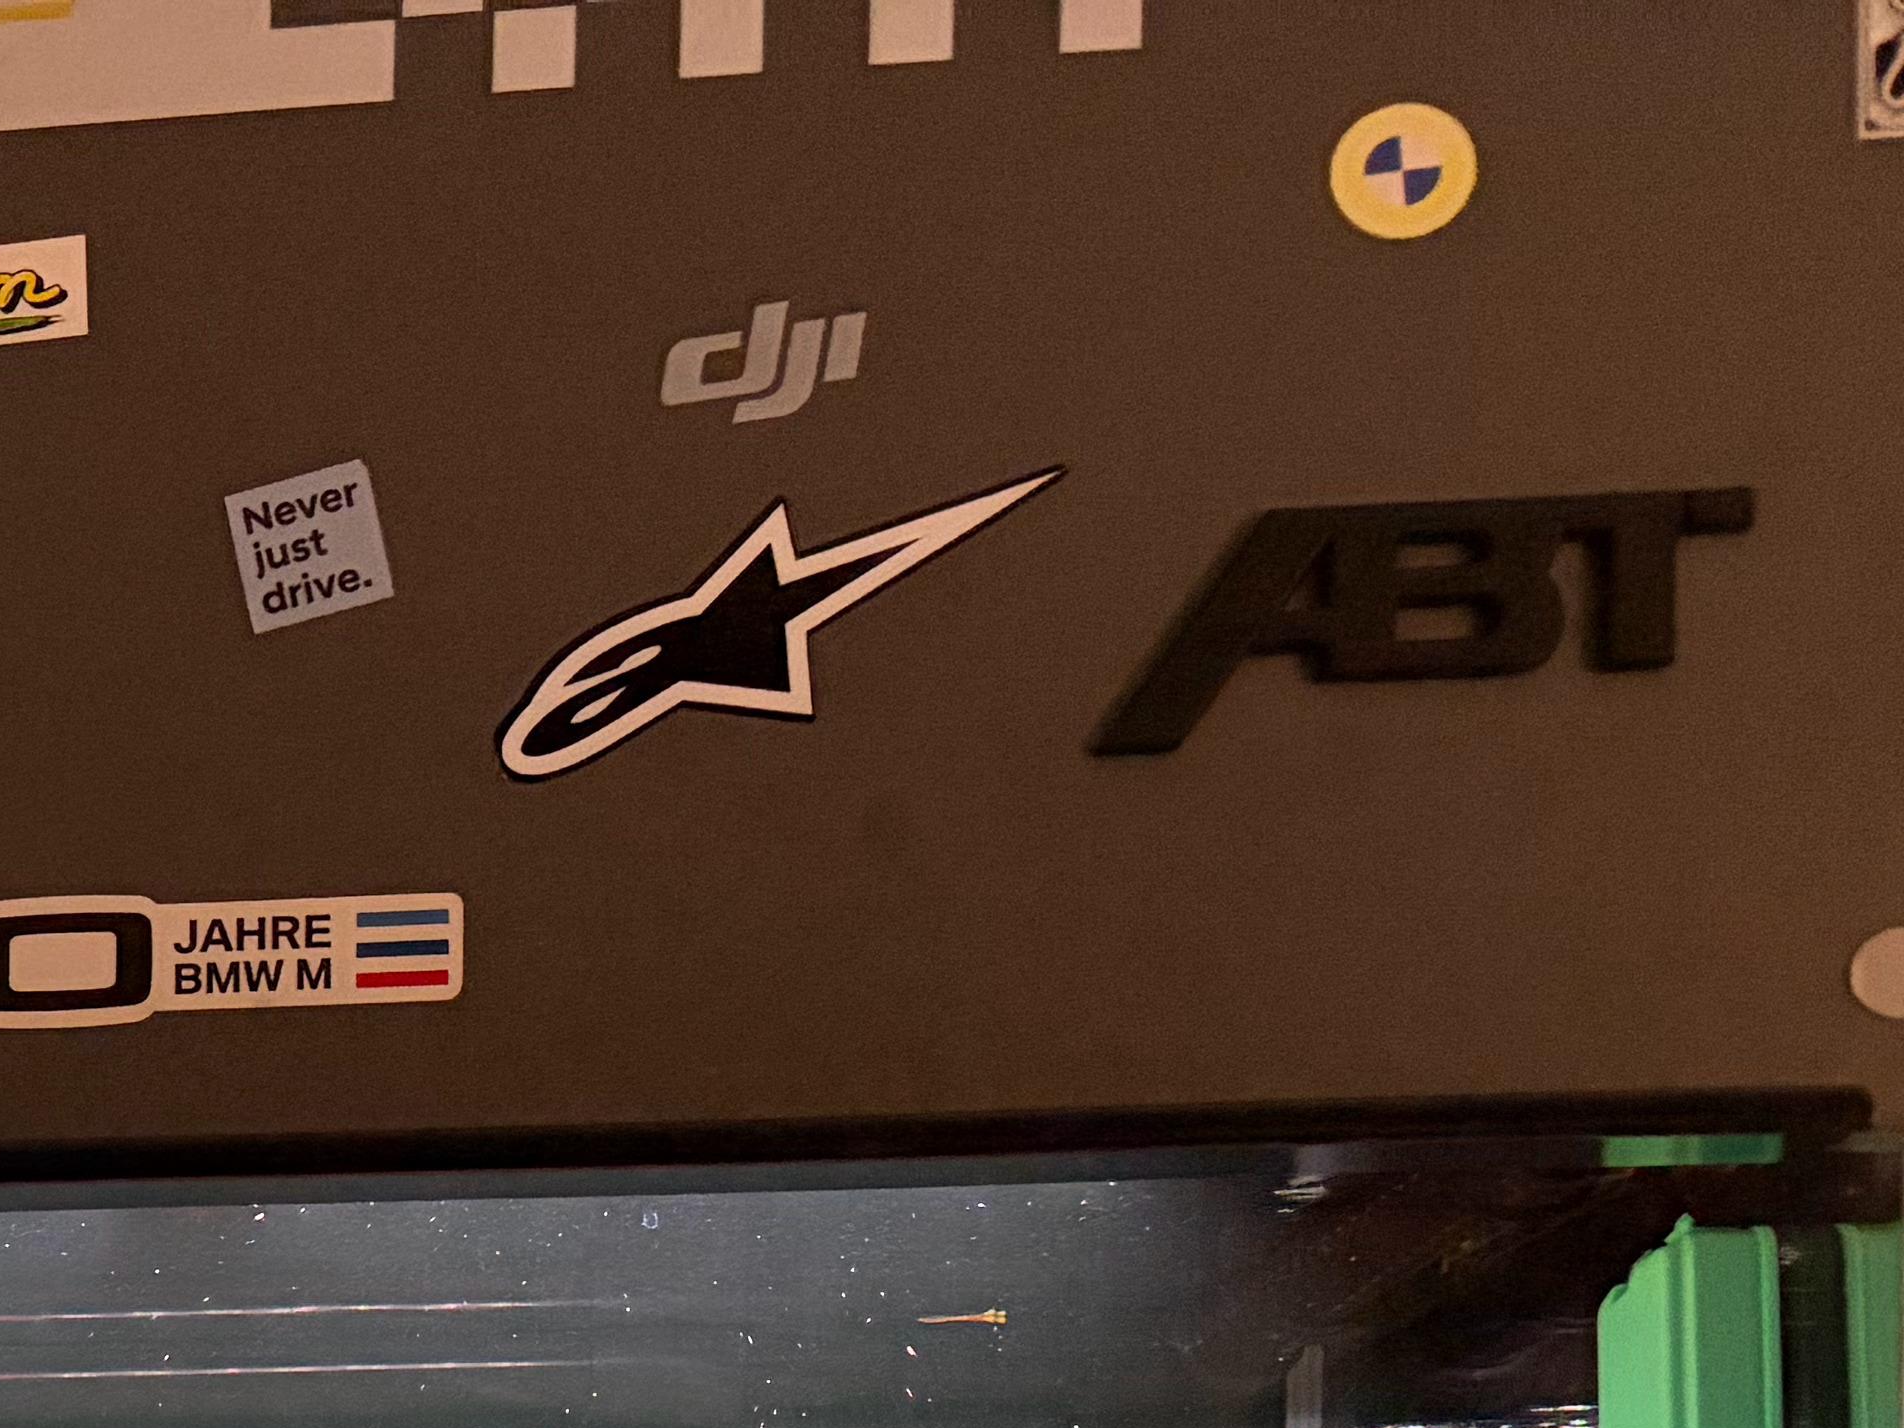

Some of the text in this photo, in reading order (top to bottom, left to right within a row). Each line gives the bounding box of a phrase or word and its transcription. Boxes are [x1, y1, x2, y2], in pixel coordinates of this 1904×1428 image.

[241, 481, 359, 536] Never
[252, 528, 329, 580] just
[261, 568, 374, 615] drive.
[1084, 485, 1758, 759] ABT
[173, 913, 333, 955] JAHRE
[173, 956, 333, 996] BMW M
